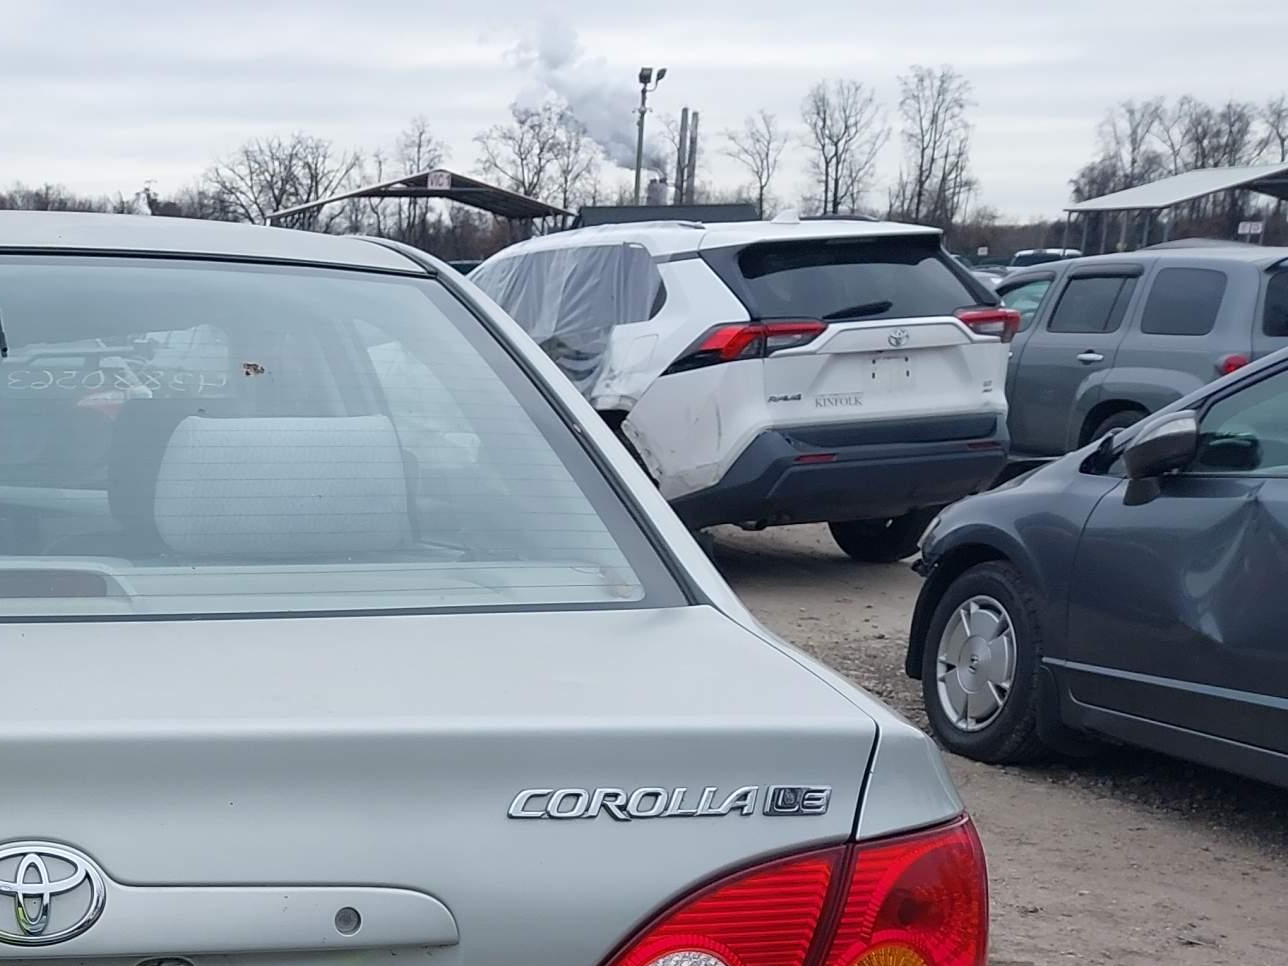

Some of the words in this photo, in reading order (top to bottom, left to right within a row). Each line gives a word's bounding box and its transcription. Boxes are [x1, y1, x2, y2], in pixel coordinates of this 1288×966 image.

[815, 395, 863, 408] KINFOLK
[507, 786, 759, 821] COROLLA
[763, 784, 832, 816] LE
